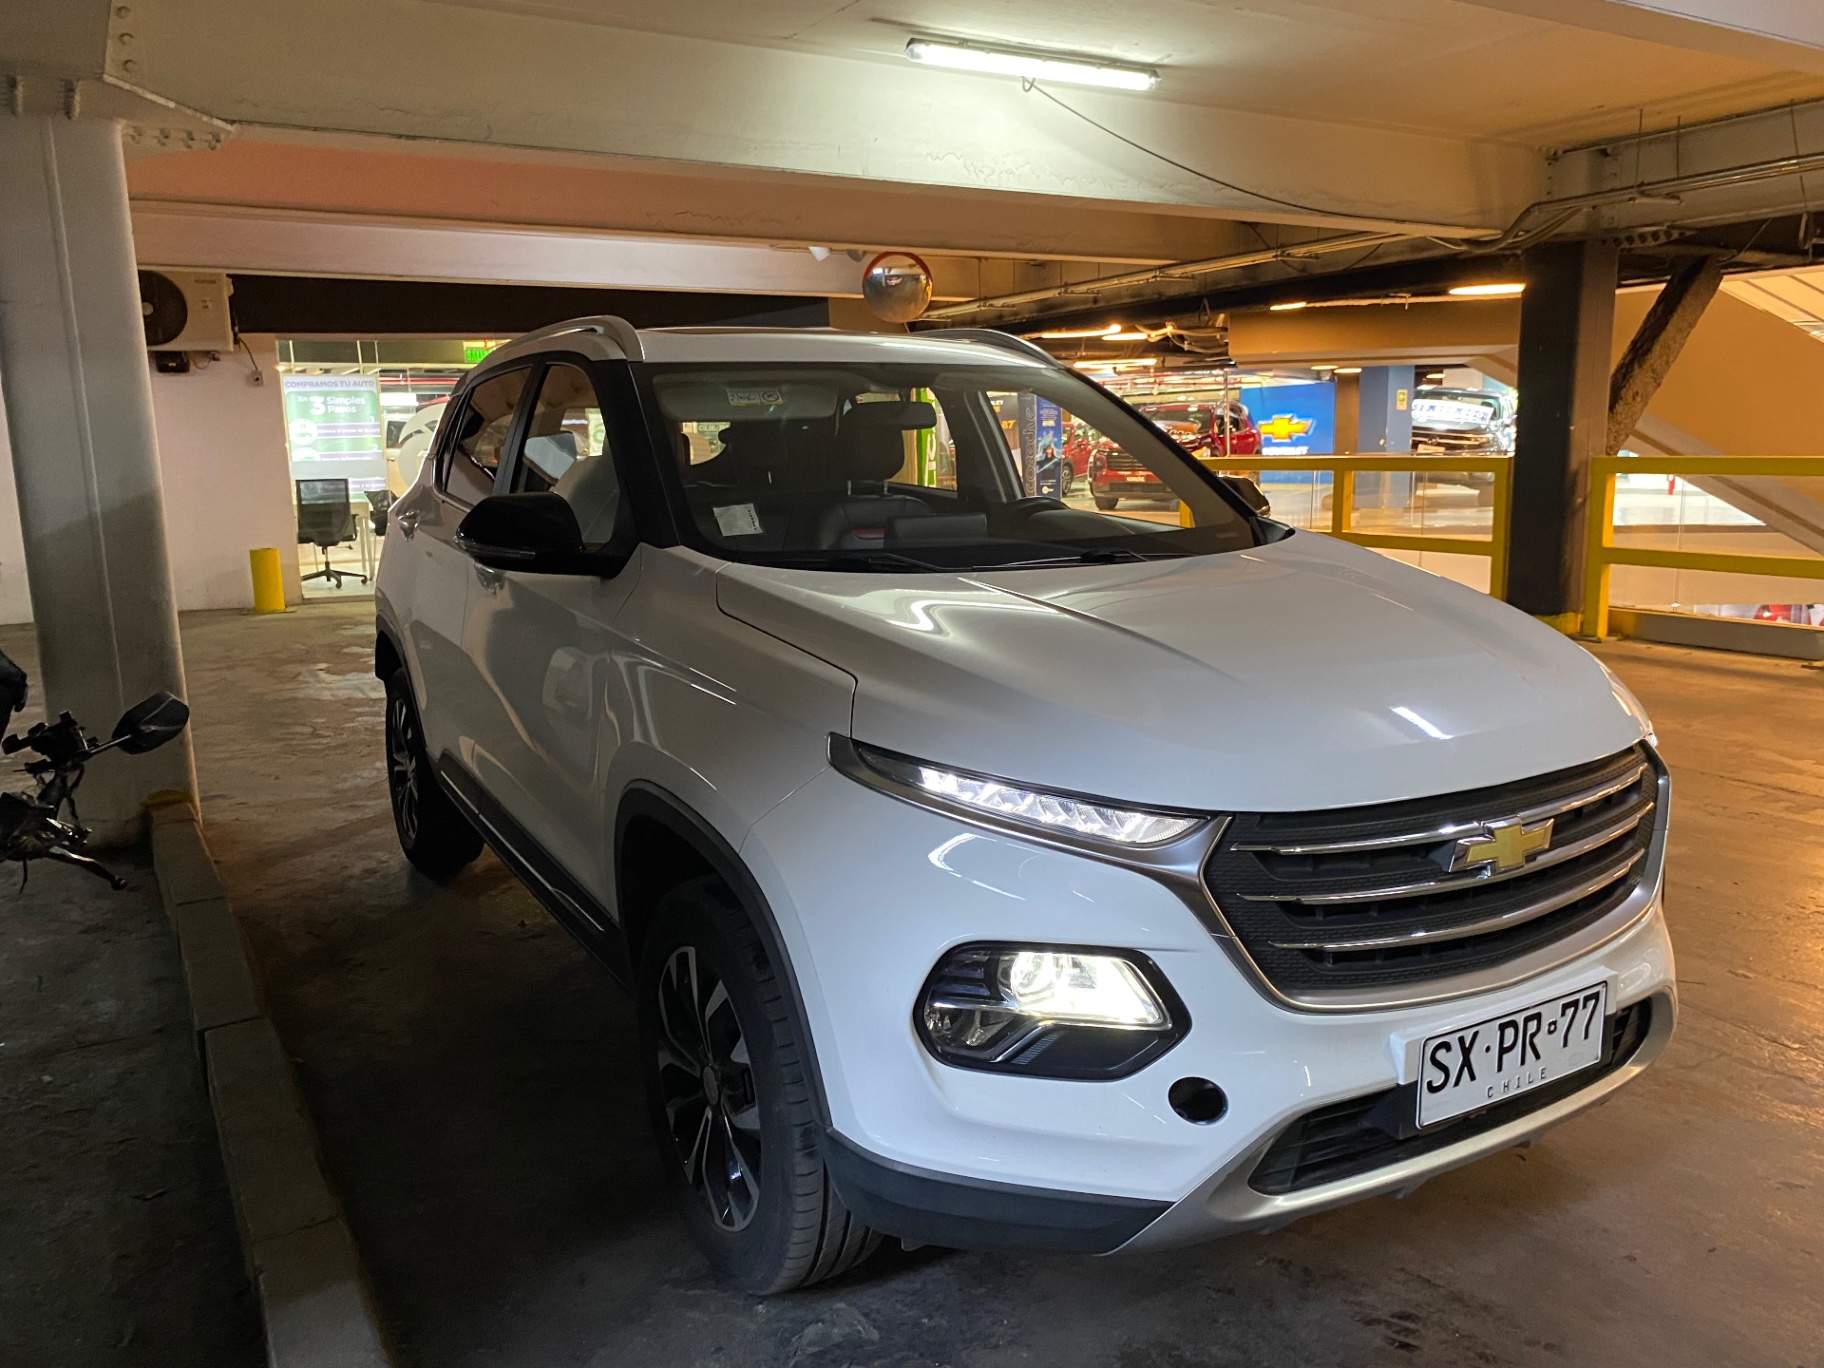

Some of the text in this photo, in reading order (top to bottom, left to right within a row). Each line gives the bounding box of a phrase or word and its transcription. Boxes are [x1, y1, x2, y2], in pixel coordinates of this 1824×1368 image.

[285, 380, 375, 389] COMPRAMOS TU AUTO
[309, 396, 326, 416] 3
[327, 396, 365, 405] Simples
[328, 405, 357, 413] Pasos
[1487, 1067, 1547, 1098] CHILE
